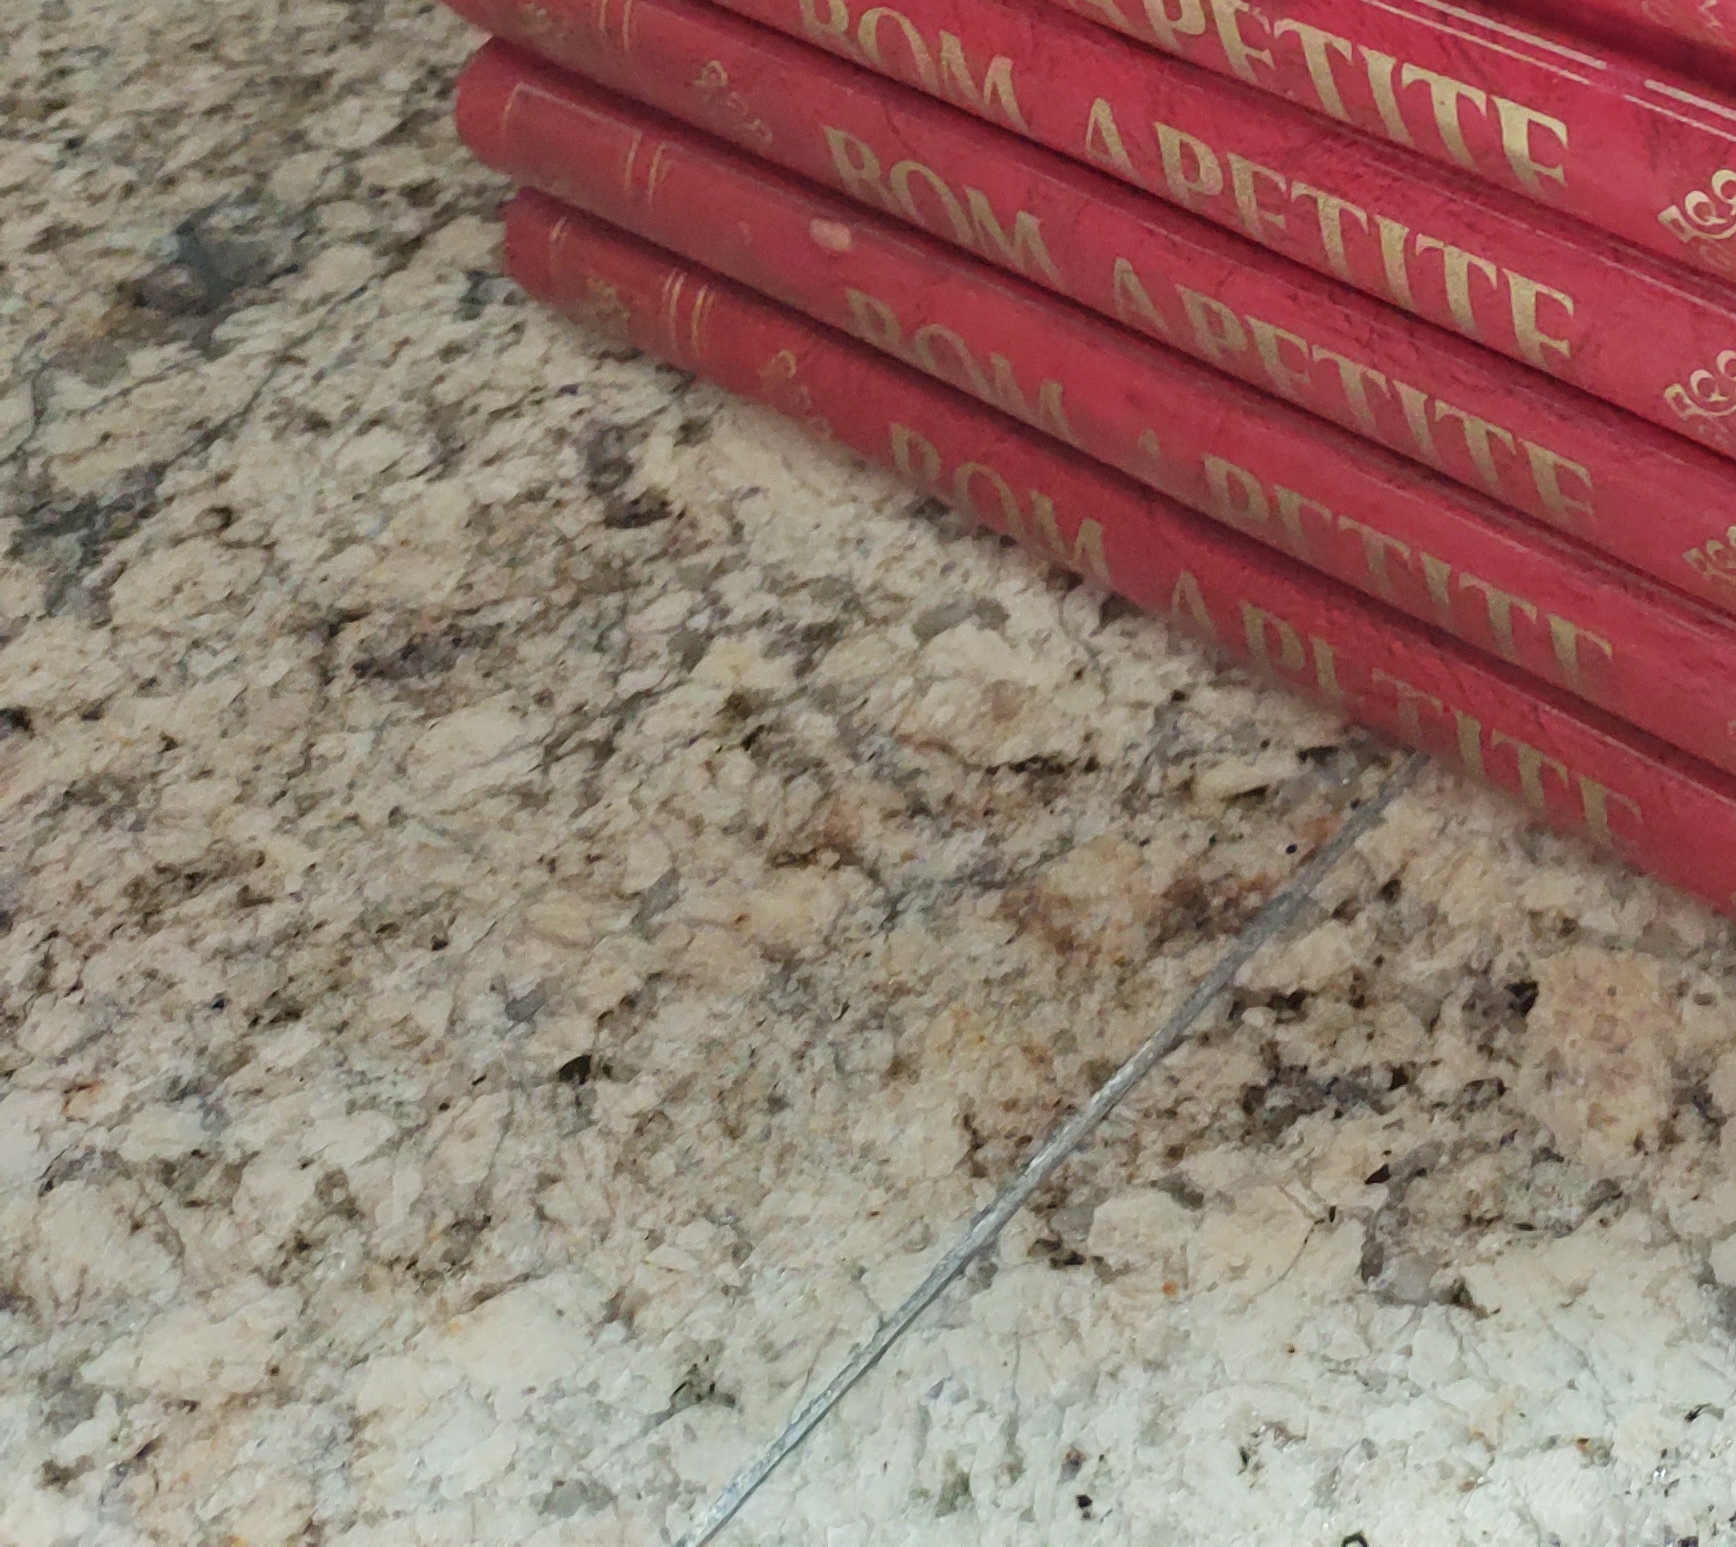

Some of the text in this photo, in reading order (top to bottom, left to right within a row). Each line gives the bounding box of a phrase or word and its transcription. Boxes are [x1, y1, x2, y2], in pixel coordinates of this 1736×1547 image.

[823, 125, 1596, 527] BOM APETITE
[1085, 96, 1575, 369] APETITE
